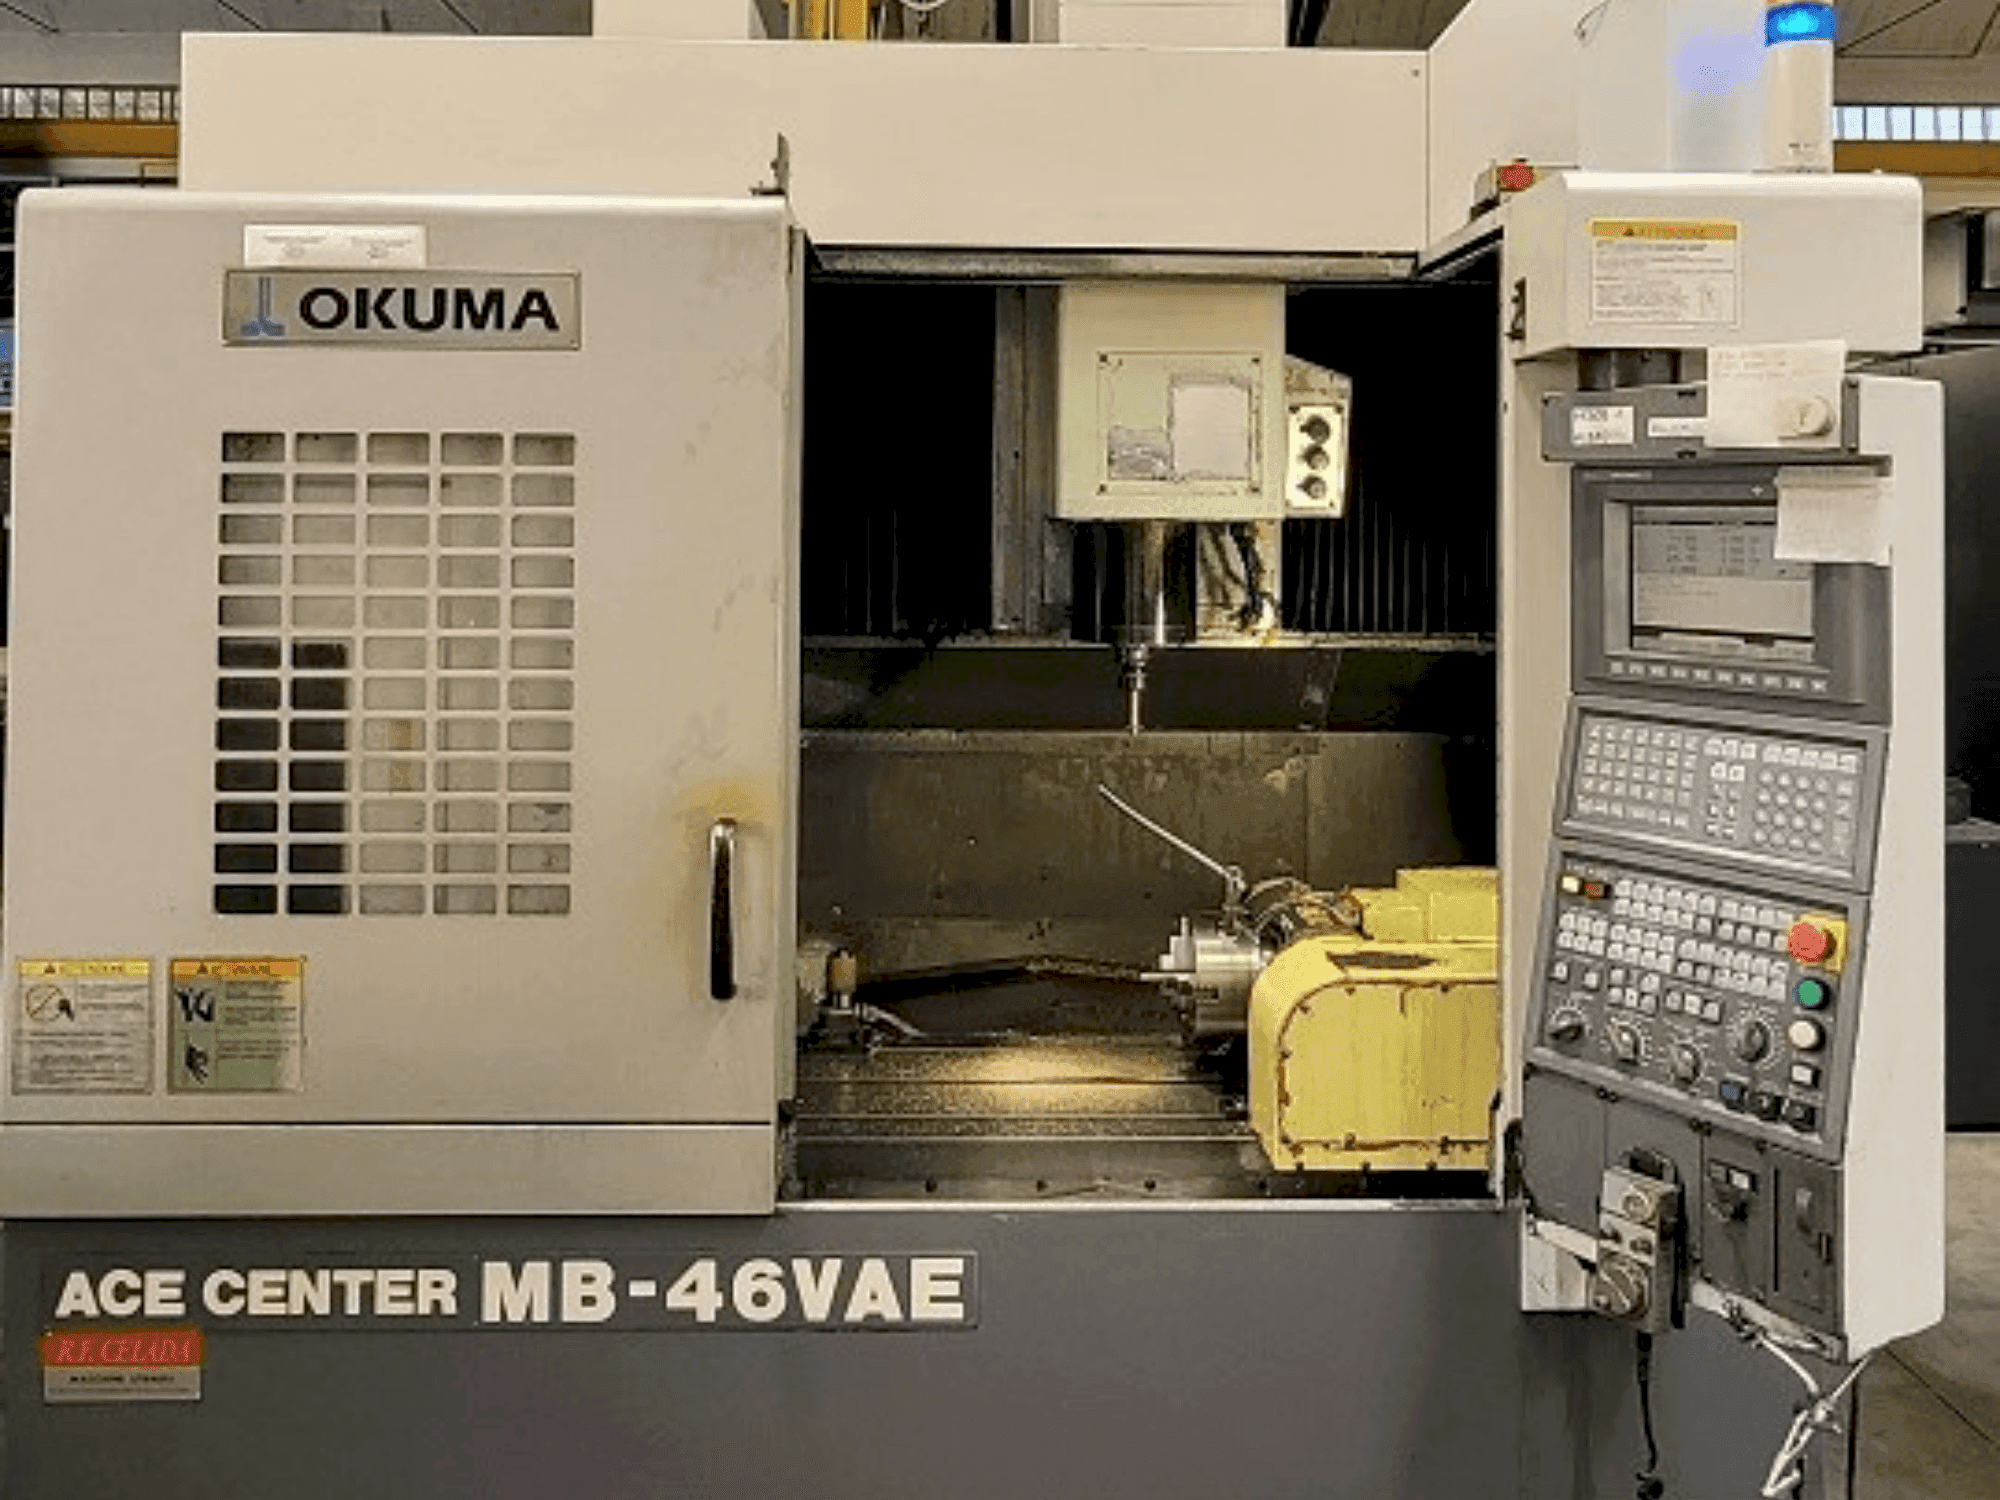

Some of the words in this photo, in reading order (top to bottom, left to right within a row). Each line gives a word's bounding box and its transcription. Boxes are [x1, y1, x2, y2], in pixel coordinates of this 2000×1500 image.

[300, 288, 559, 331] OKUMA
[56, 1269, 185, 1317] ACE
[203, 1269, 457, 1315] CENTER
[481, 1258, 965, 1322] MB-46VAE
